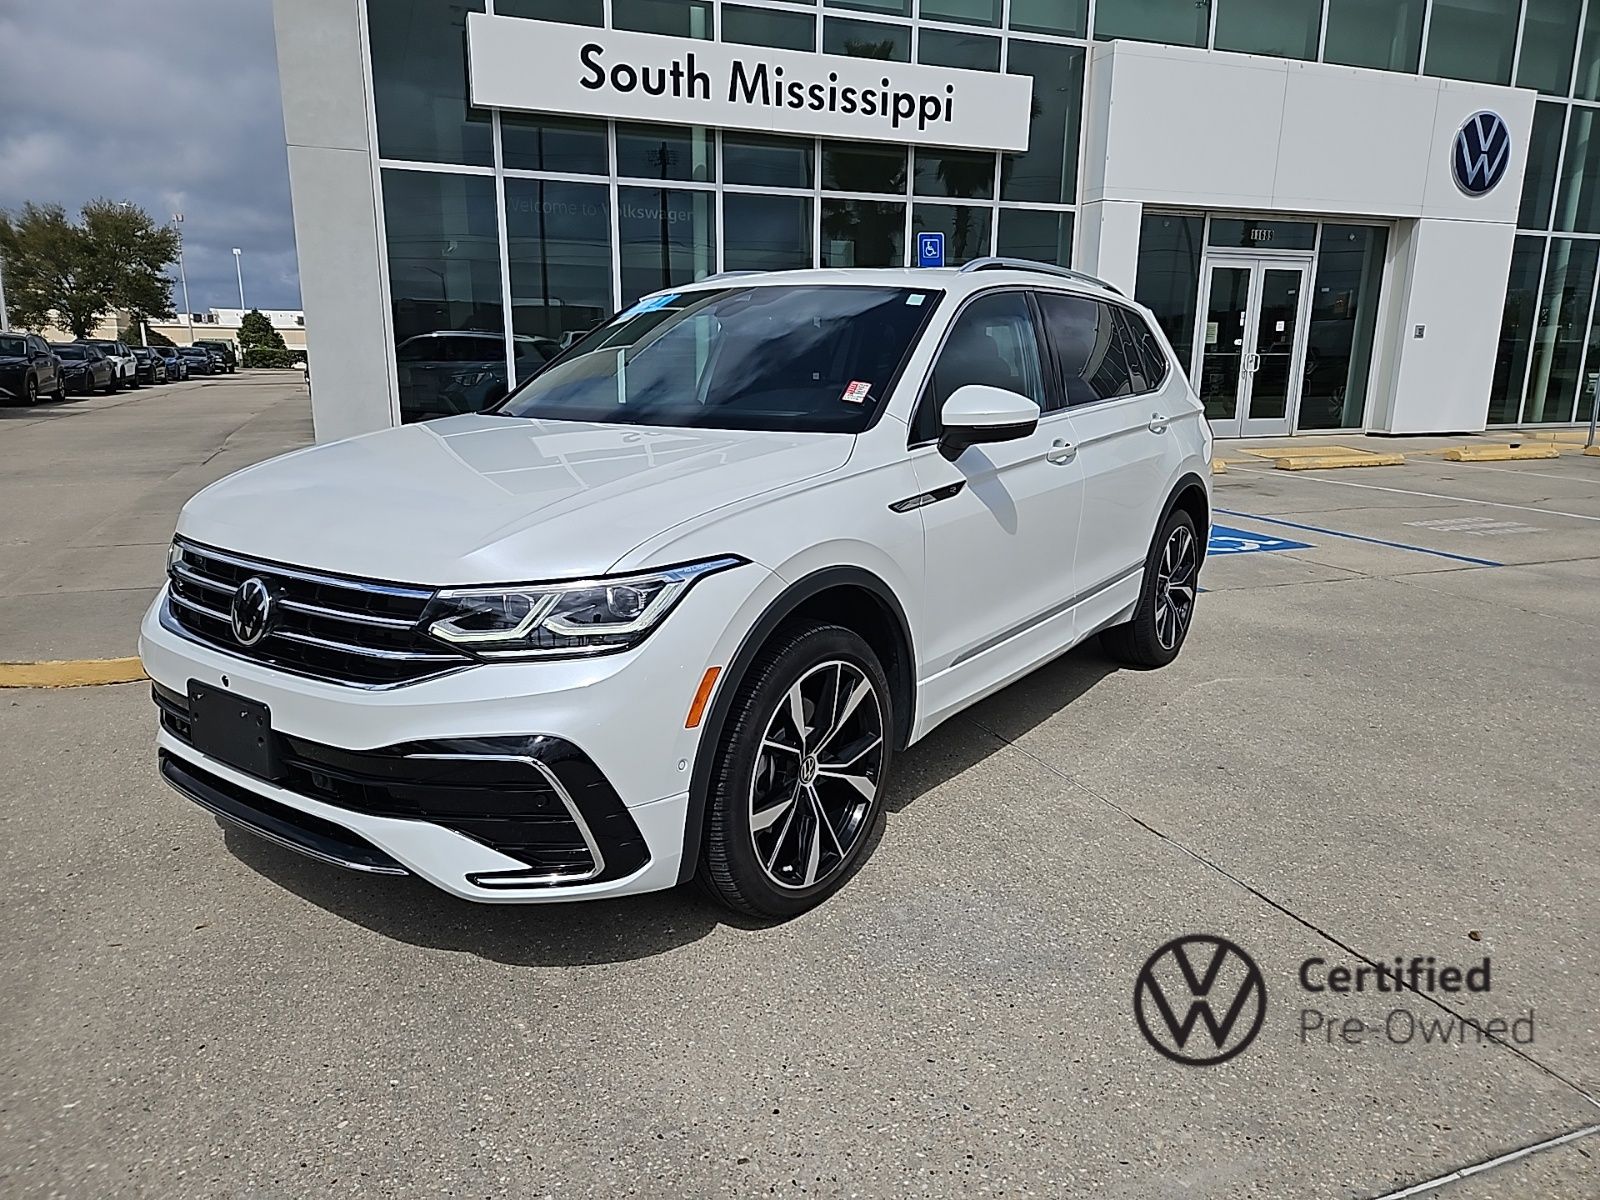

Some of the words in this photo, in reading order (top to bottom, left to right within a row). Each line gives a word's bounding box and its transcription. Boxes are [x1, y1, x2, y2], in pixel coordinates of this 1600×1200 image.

[580, 43, 711, 101] South
[728, 60, 955, 130] Mississippi
[1457, 112, 1510, 189] VW
[507, 197, 577, 216] Welcome
[582, 202, 597, 216] to
